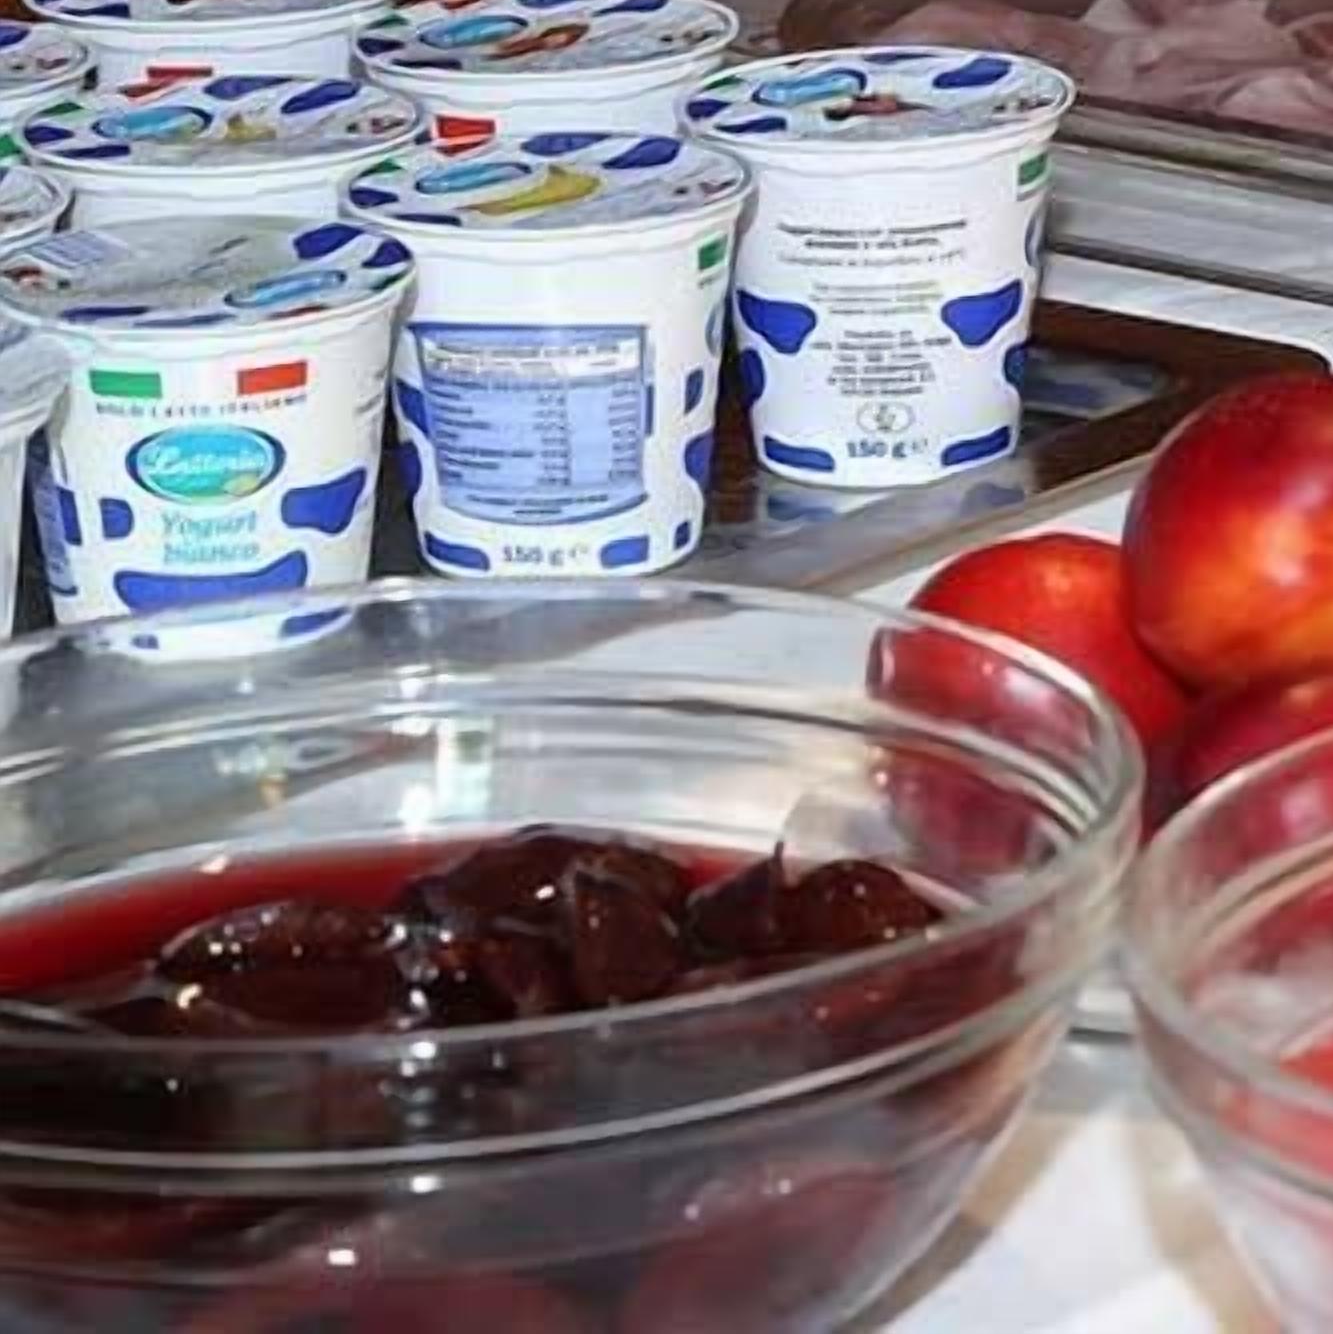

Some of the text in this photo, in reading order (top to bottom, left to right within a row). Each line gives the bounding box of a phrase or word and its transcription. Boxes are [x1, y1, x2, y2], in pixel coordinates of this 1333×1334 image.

[847, 438, 888, 458] 150
[161, 510, 257, 539] Yogurt
[163, 541, 260, 565] bianco
[502, 544, 543, 564] 150
